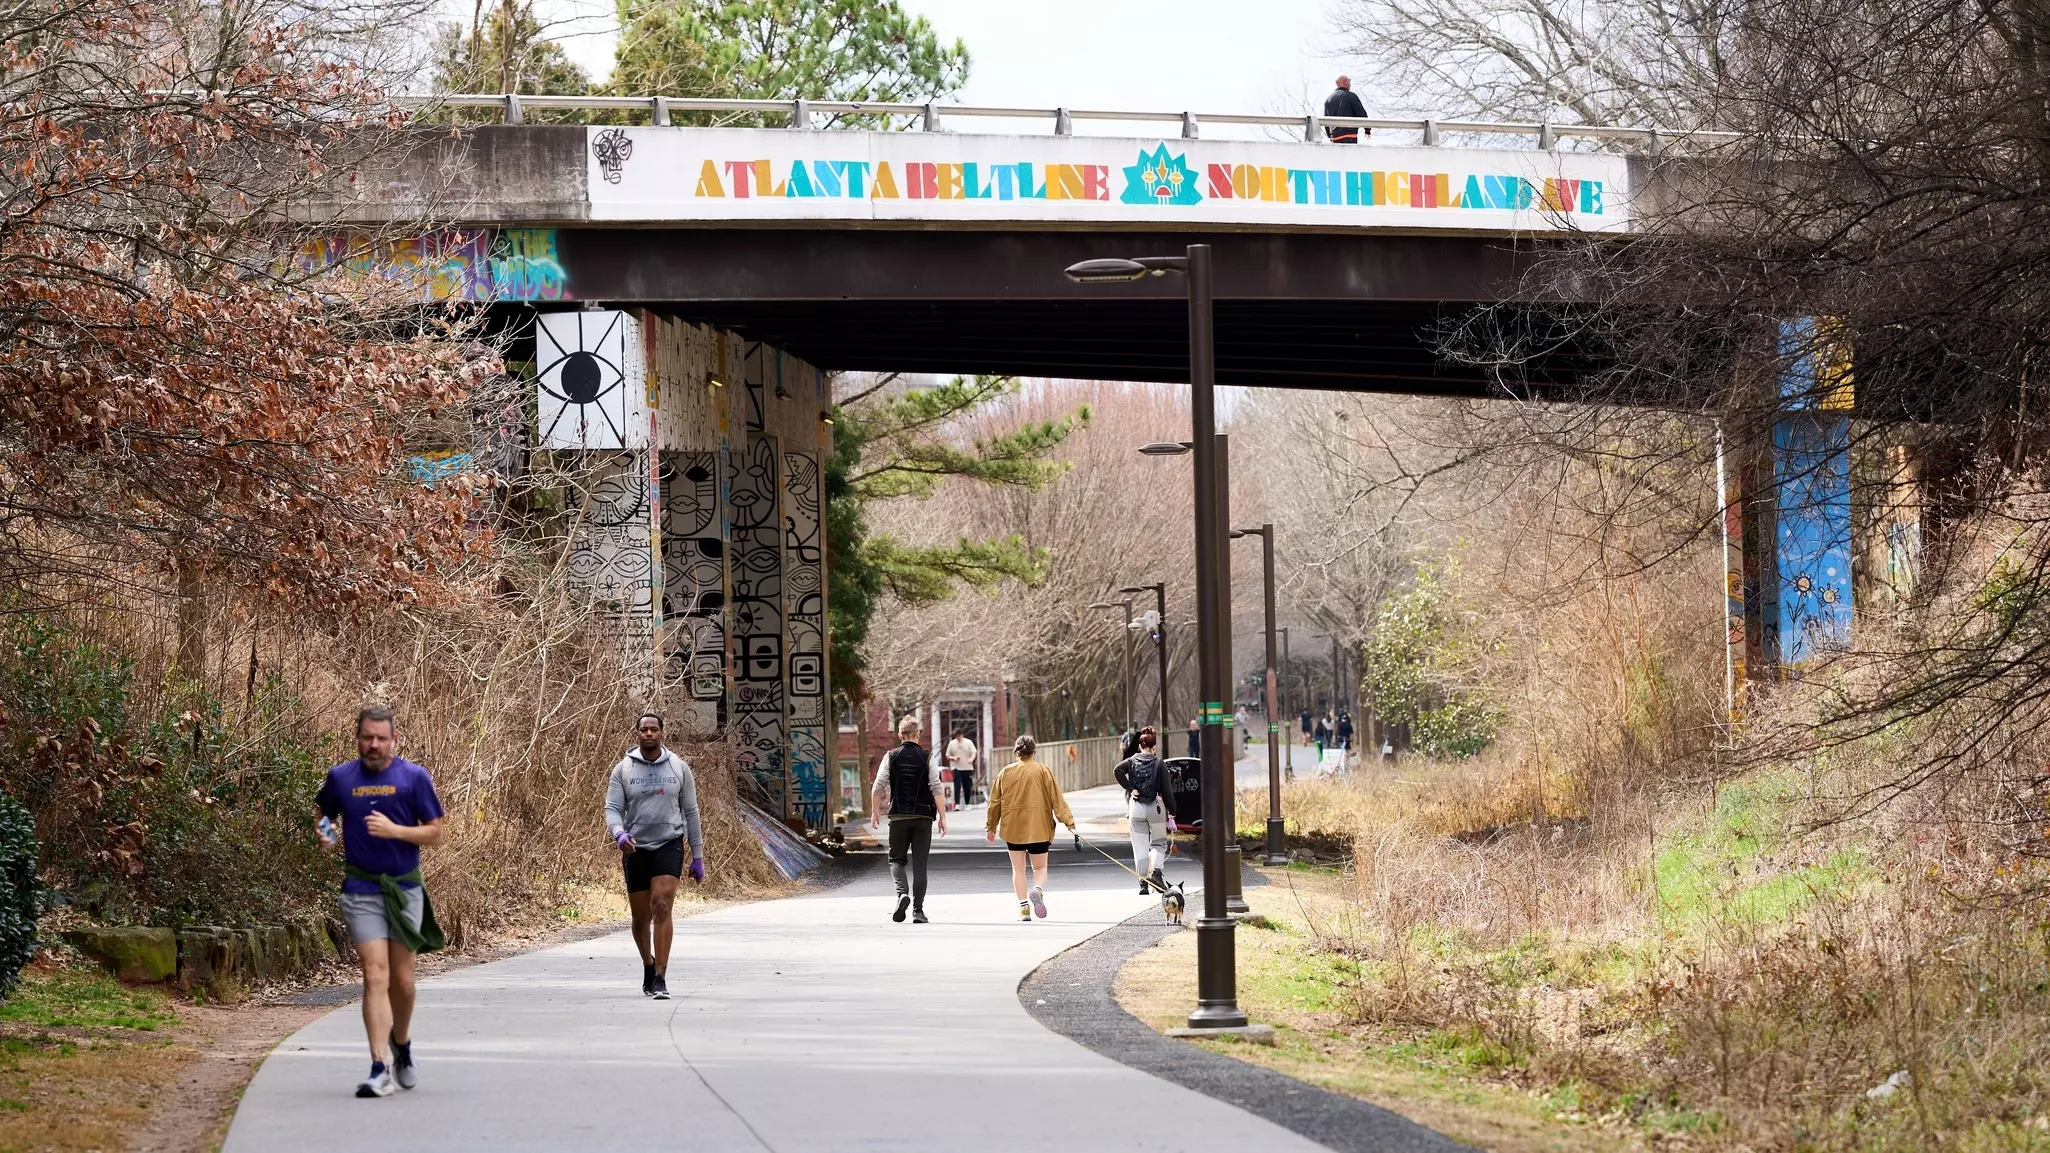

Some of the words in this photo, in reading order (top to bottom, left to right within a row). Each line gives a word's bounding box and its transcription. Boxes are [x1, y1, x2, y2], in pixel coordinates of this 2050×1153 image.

[695, 160, 900, 198] ATLANTA
[906, 162, 1110, 201] BELTLINE
[1208, 163, 1342, 205] NORTH
[1346, 171, 1533, 210] HIGHLAND
[1538, 177, 1603, 214] AVE
[629, 777, 653, 785] WORLD
[653, 776, 677, 784] SERIES
